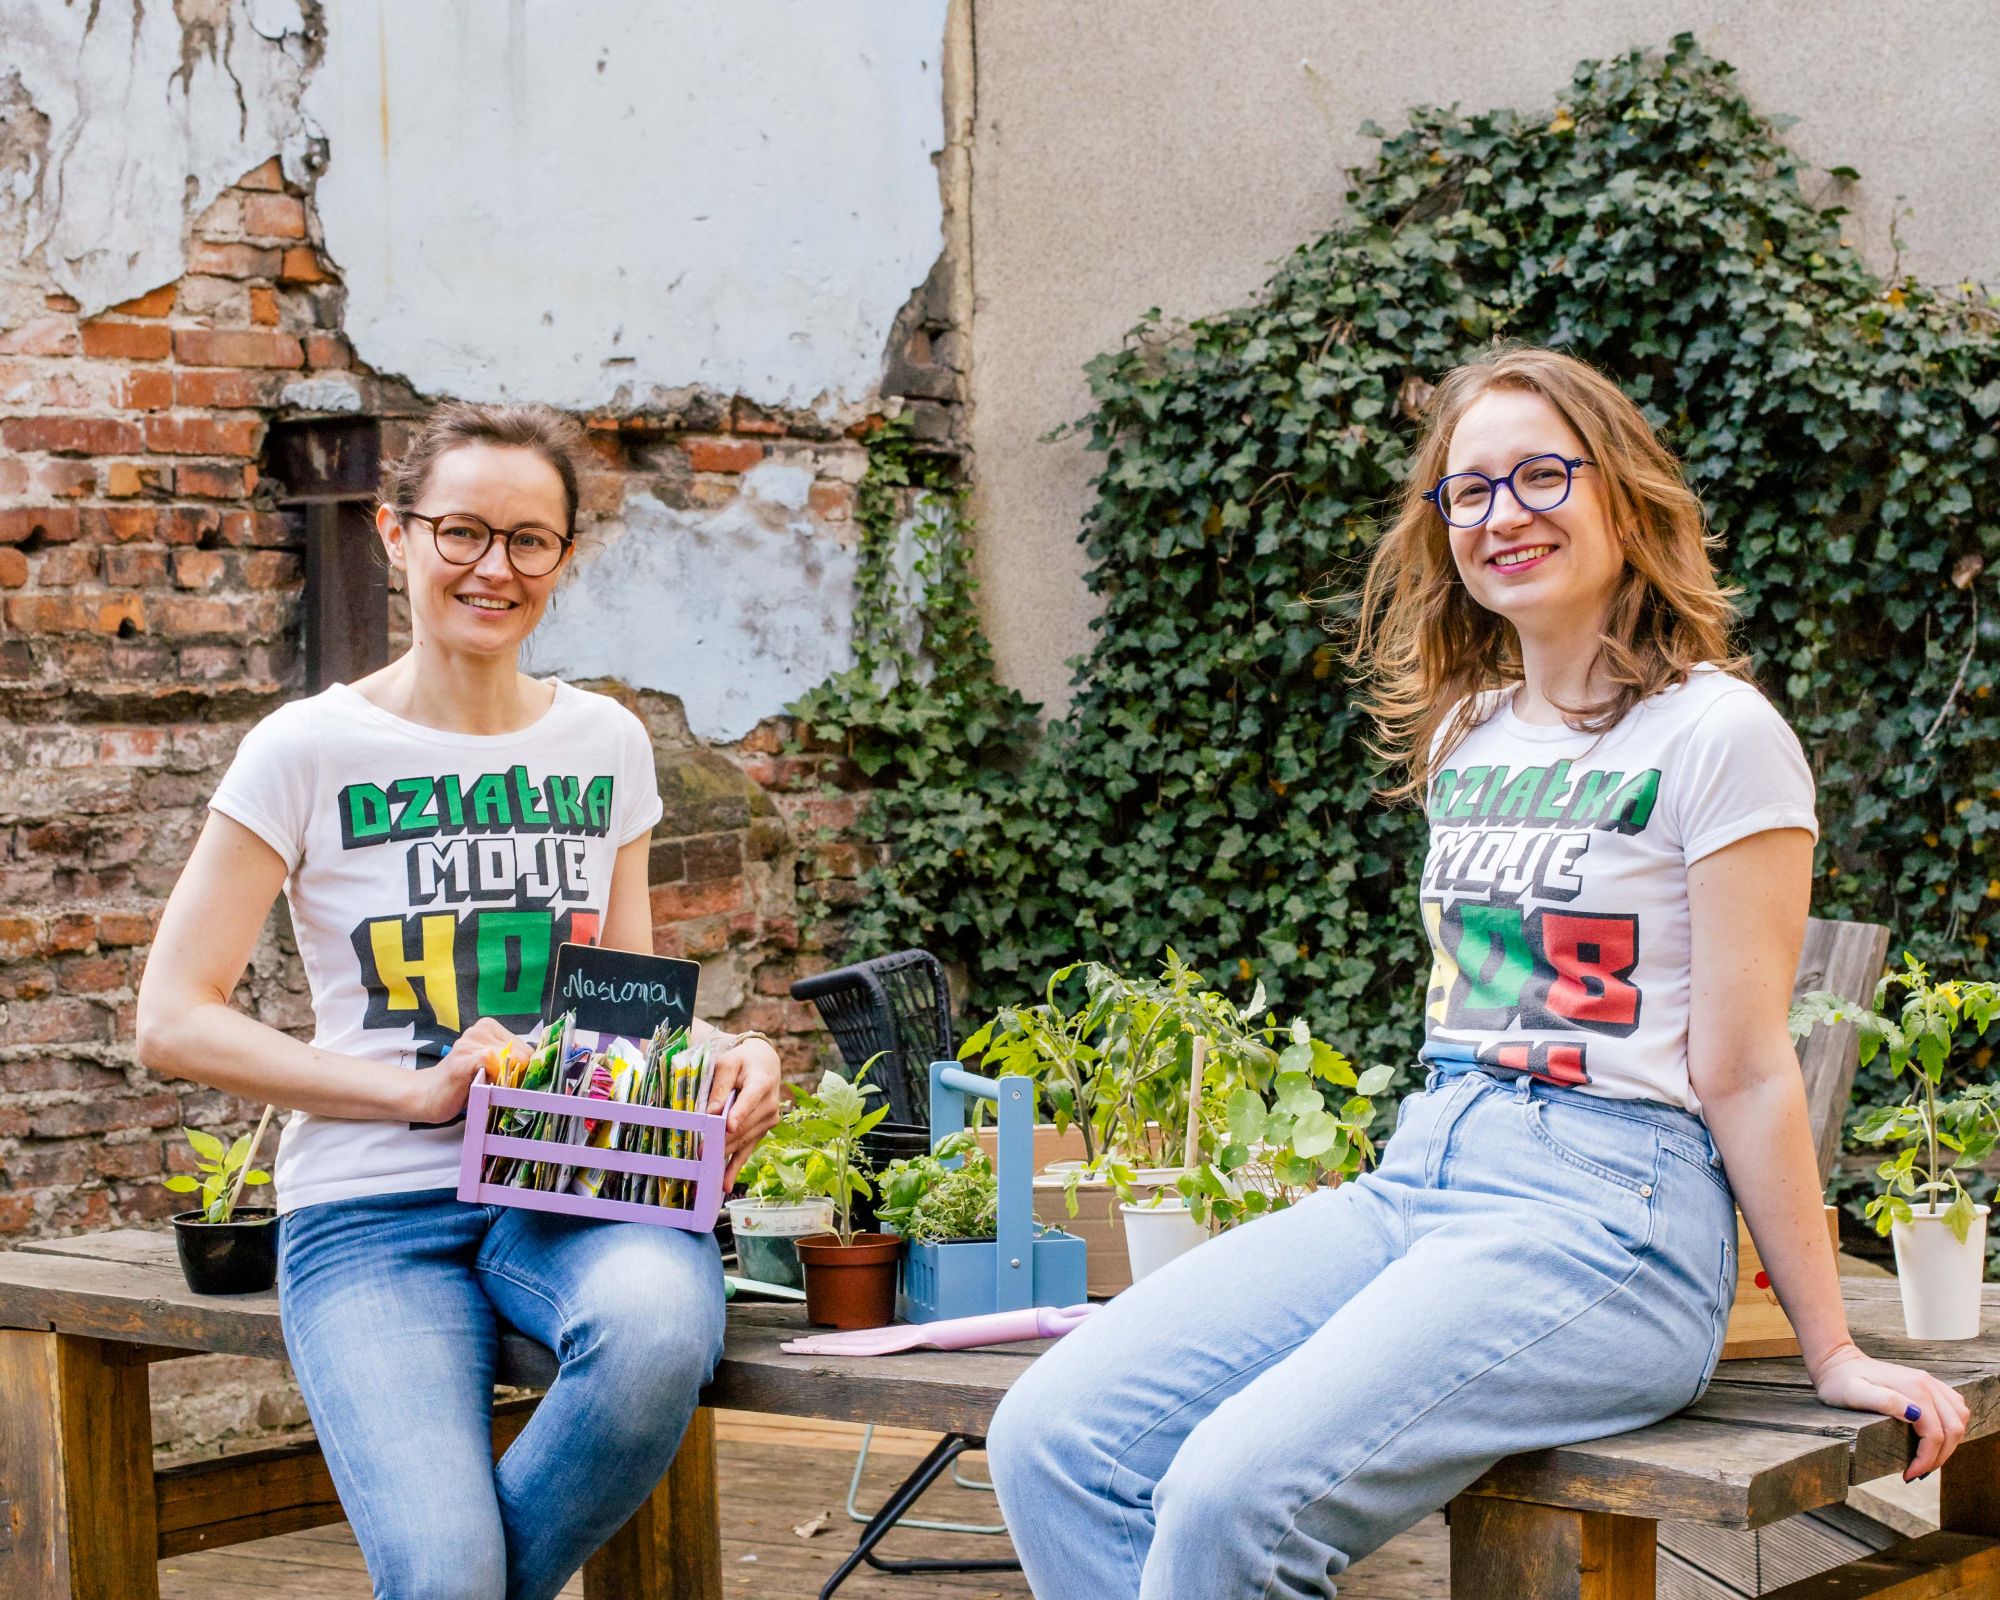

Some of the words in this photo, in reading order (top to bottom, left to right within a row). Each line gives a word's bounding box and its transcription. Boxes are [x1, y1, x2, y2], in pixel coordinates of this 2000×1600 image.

[338, 765, 614, 850] DZIAŁKA
[1429, 759, 1662, 836] DZIAŁKA
[407, 837, 589, 907] MOJE
[1423, 830, 1590, 903] MOJE
[350, 908, 600, 1036] HO
